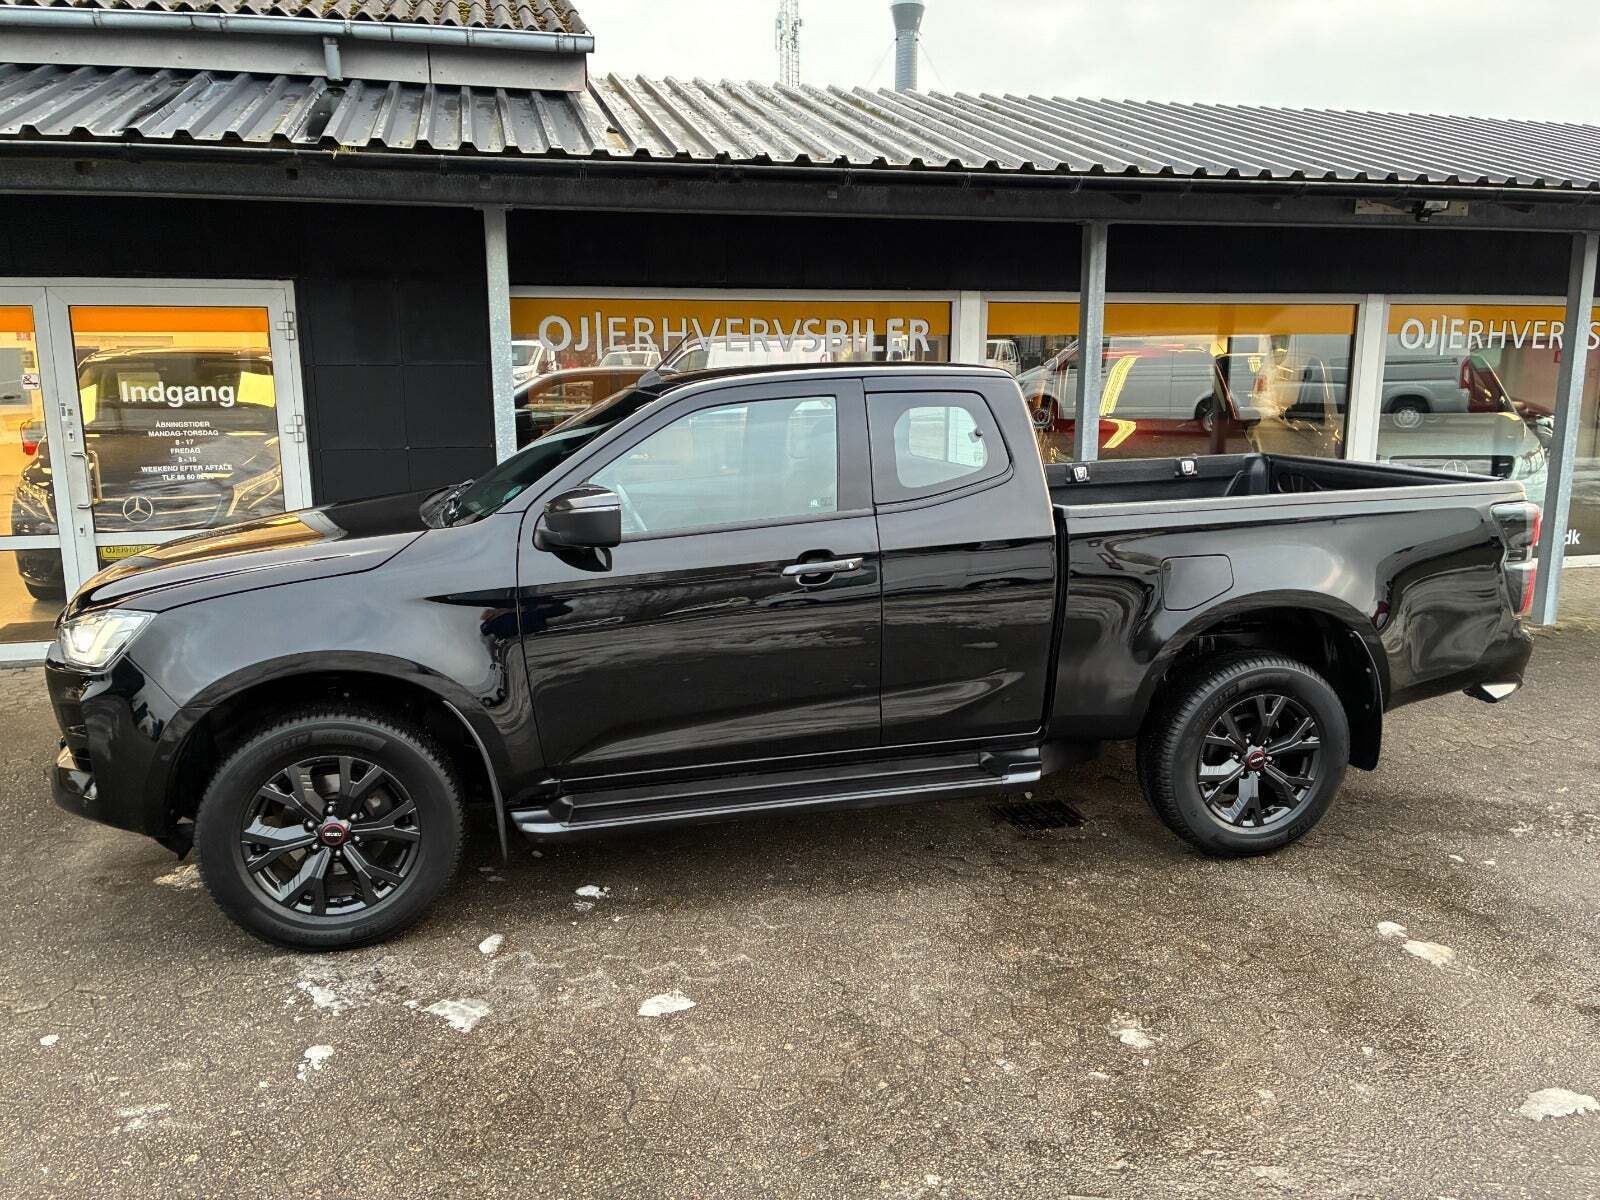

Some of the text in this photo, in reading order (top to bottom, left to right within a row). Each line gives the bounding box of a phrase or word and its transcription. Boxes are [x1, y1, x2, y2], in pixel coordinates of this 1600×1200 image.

[121, 381, 235, 408] Indgang
[155, 420, 210, 428] ÅBNINGSTIDER
[148, 429, 219, 437] MANDAG-TORSDAG
[170, 447, 201, 455] FREDAG
[141, 465, 178, 473] WEEKEND
